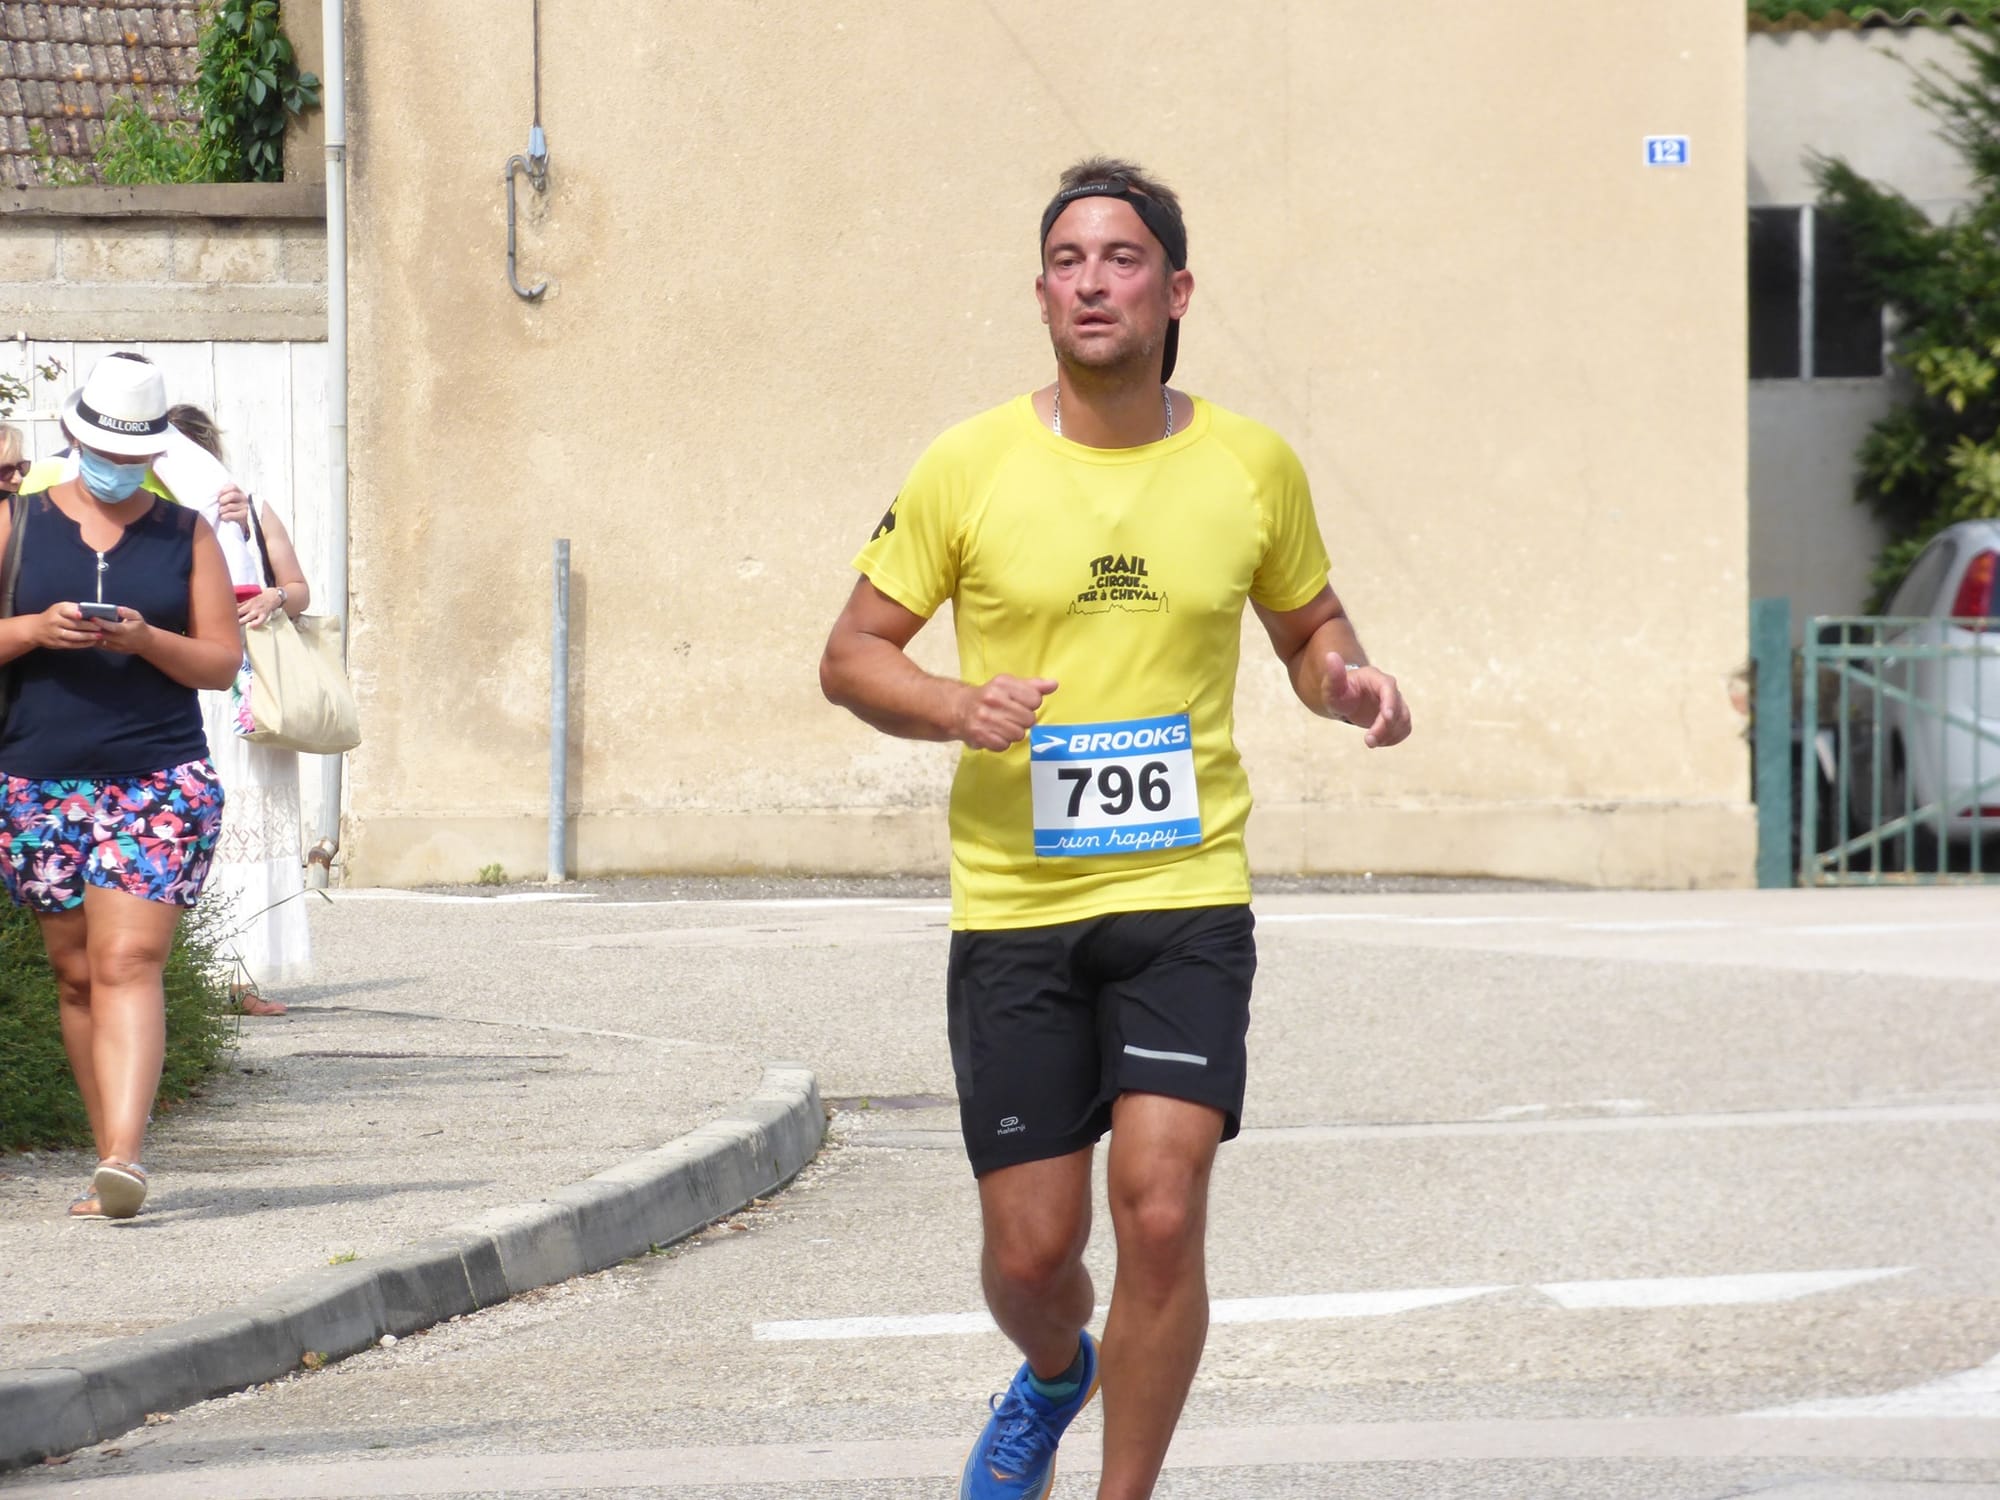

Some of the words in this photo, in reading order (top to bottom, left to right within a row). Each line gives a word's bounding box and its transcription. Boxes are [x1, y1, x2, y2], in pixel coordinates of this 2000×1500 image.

[1653, 140, 1680, 161] 12
[98, 414, 151, 432] MALLORCA
[1089, 553, 1148, 577] TRAIL
[1096, 575, 1141, 588] CIRQUE
[1078, 591, 1098, 602] FER
[1110, 588, 1158, 601] CHEVAL
[1068, 724, 1187, 753] BROOKS
[1057, 761, 1171, 818] 796
[1056, 837, 1100, 849] run
[1106, 828, 1178, 850] happy
